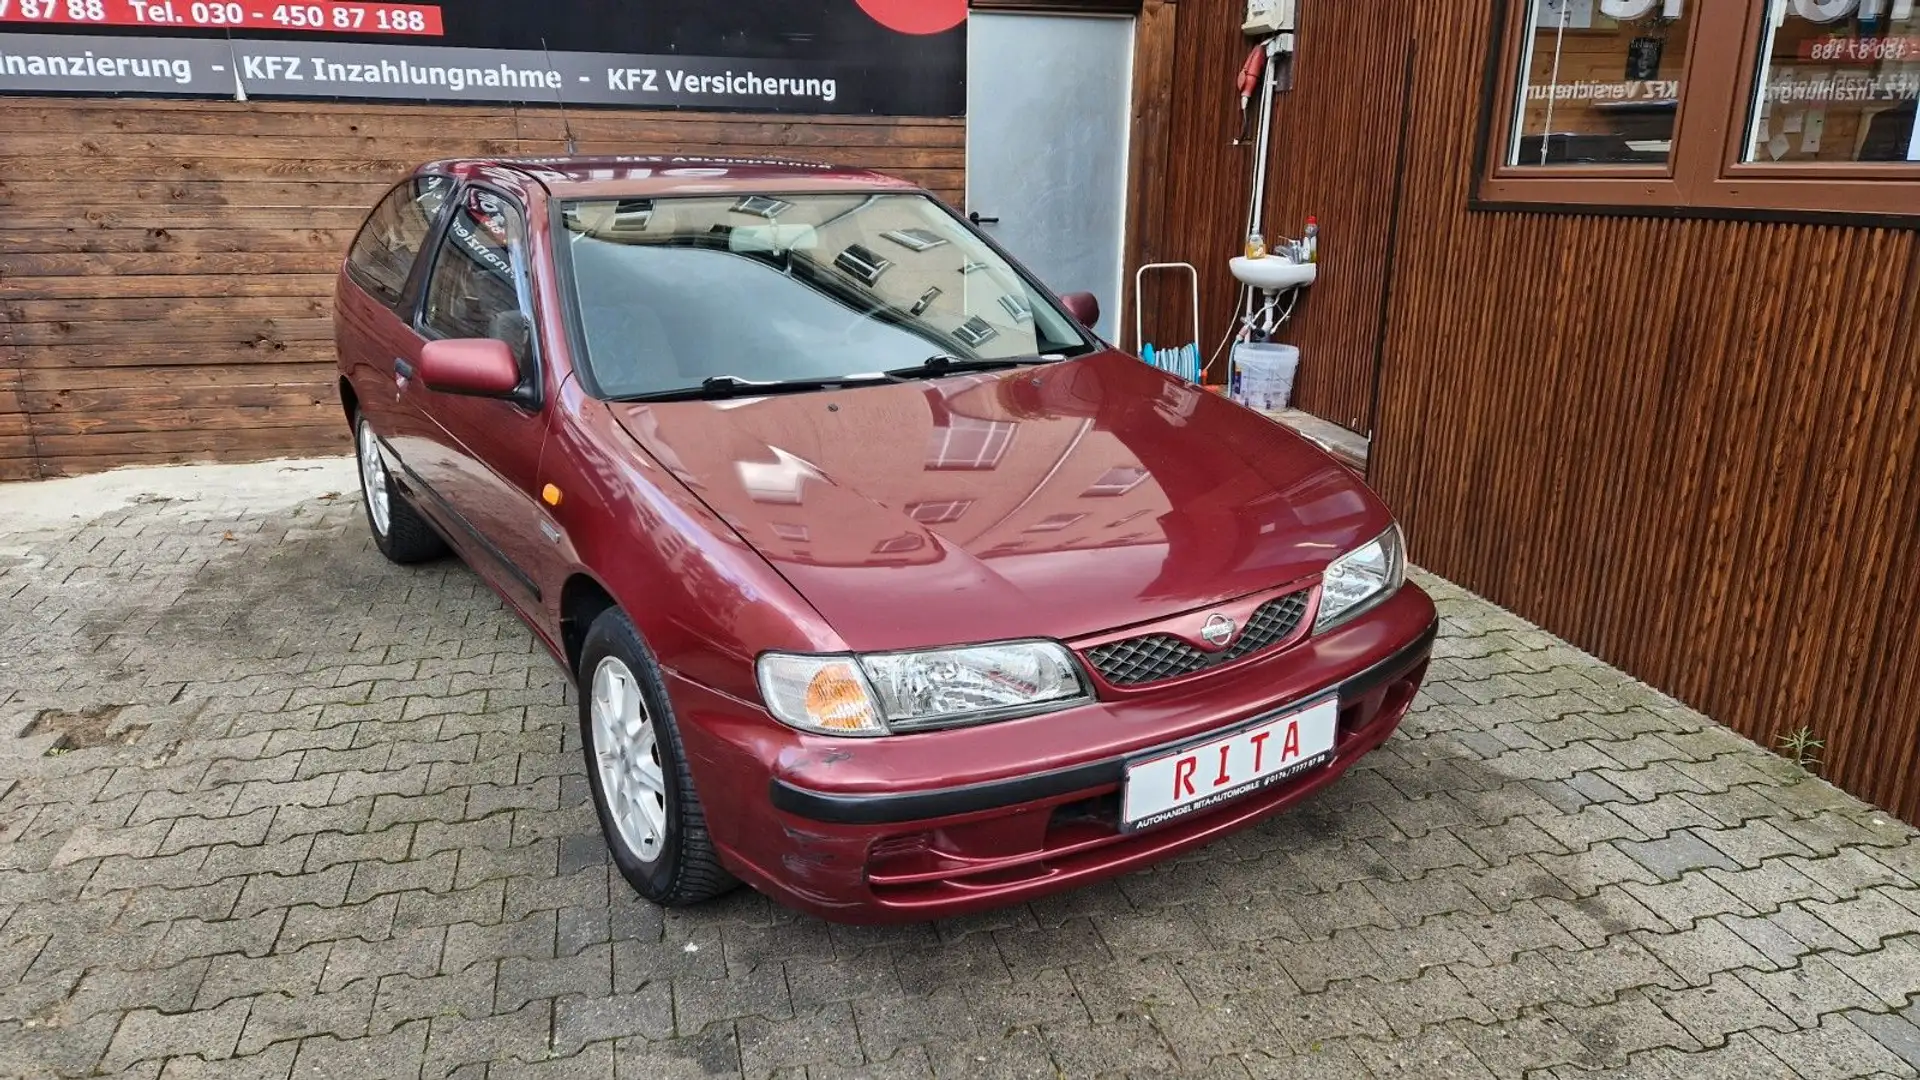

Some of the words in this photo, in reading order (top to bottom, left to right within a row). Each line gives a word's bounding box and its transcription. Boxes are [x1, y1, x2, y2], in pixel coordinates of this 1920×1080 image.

[19, 0, 57, 19] 87
[66, 0, 106, 21] 88
[128, 0, 184, 23] Tel.
[190, 2, 244, 24] 030
[272, 4, 325, 27] 450
[332, 7, 366, 28] 87
[376, 9, 426, 31] 188
[242, 55, 304, 80] KFZ
[310, 57, 563, 91] Inzahlungnahme
[606, 68, 660, 91] KFZ
[664, 70, 837, 101] Versicherung
[1173, 720, 1300, 801] RITA
[1136, 805, 1193, 829] AUTOHANDEL
[1193, 781, 1260, 810] RITA-AUTOMOBILE
